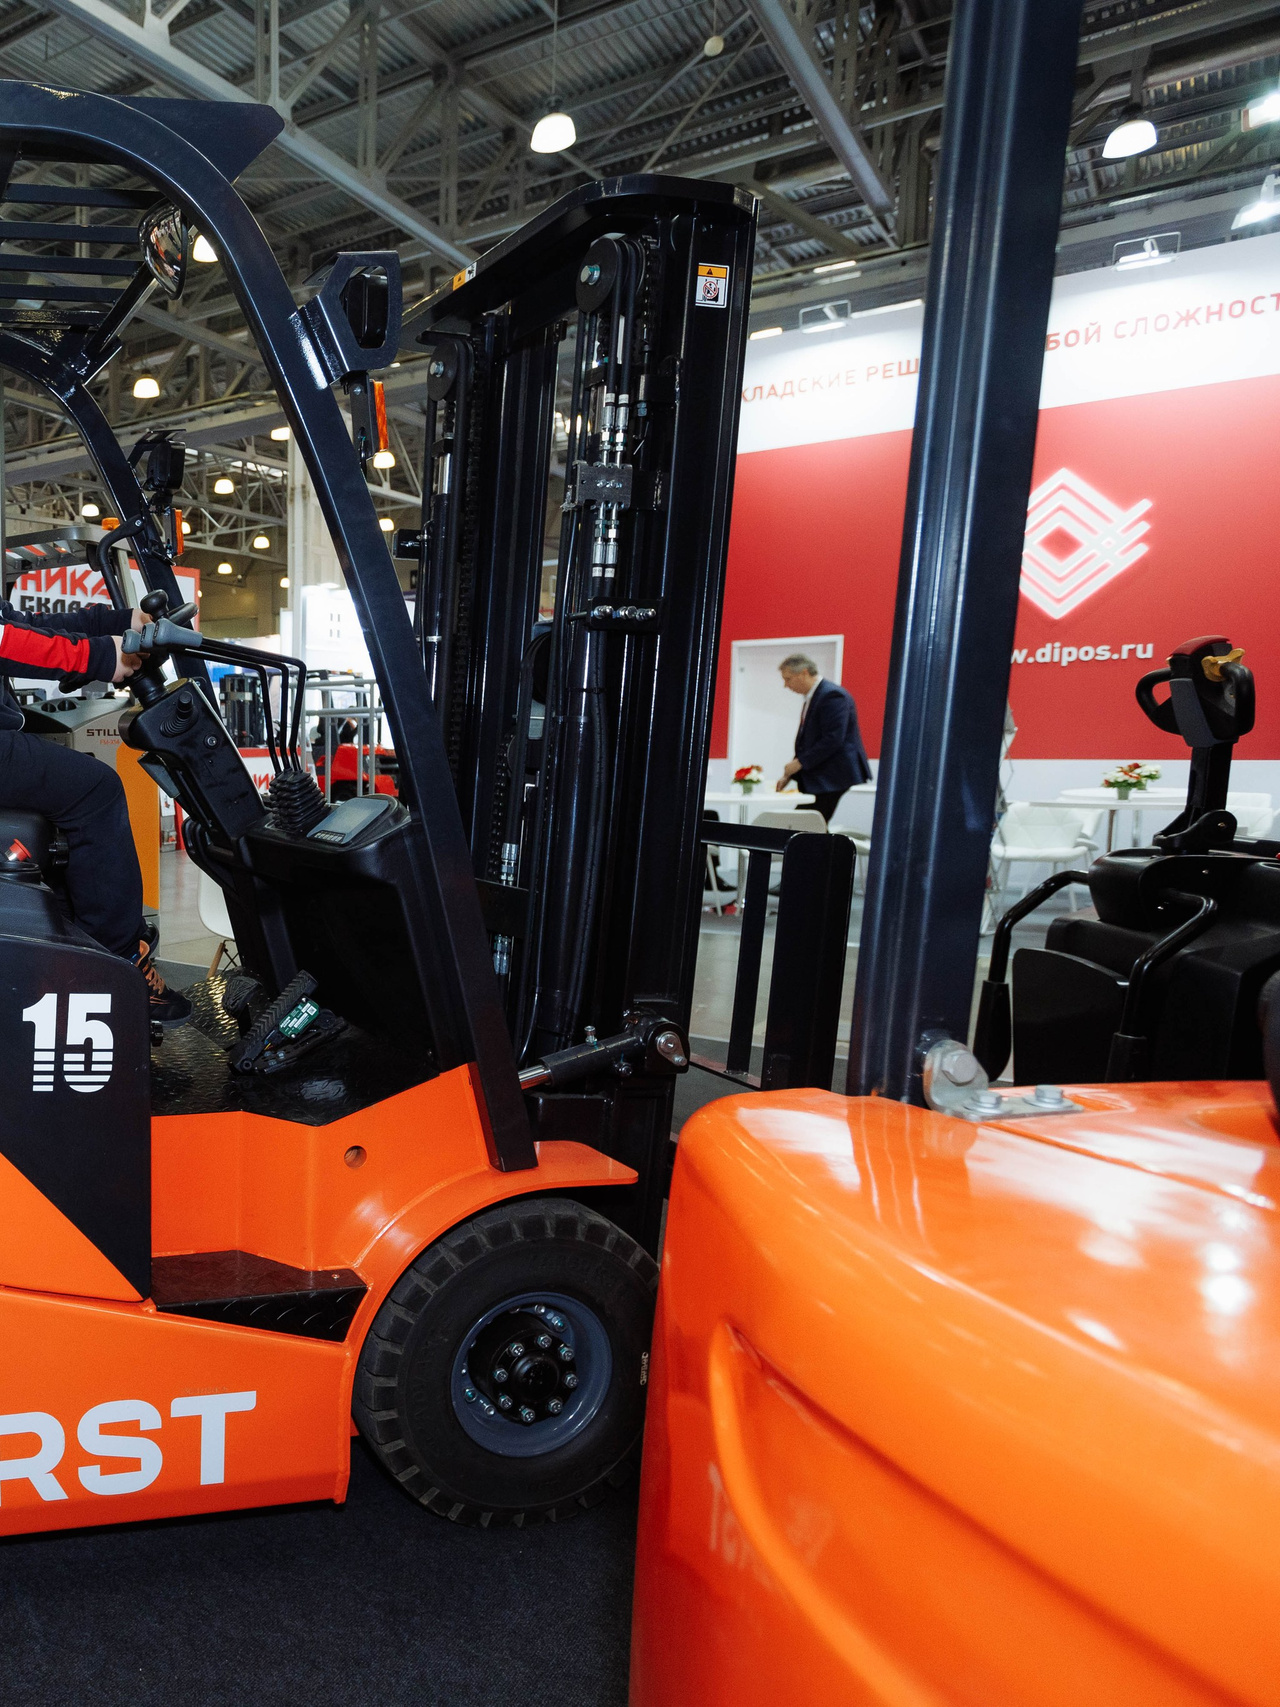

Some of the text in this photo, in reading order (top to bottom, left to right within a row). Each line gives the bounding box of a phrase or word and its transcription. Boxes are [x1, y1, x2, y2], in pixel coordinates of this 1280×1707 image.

[866, 358, 920, 382] РЕШ
[14, 566, 111, 599] НИКА
[86, 728, 120, 737] STILL
[22, 993, 114, 1093] 15
